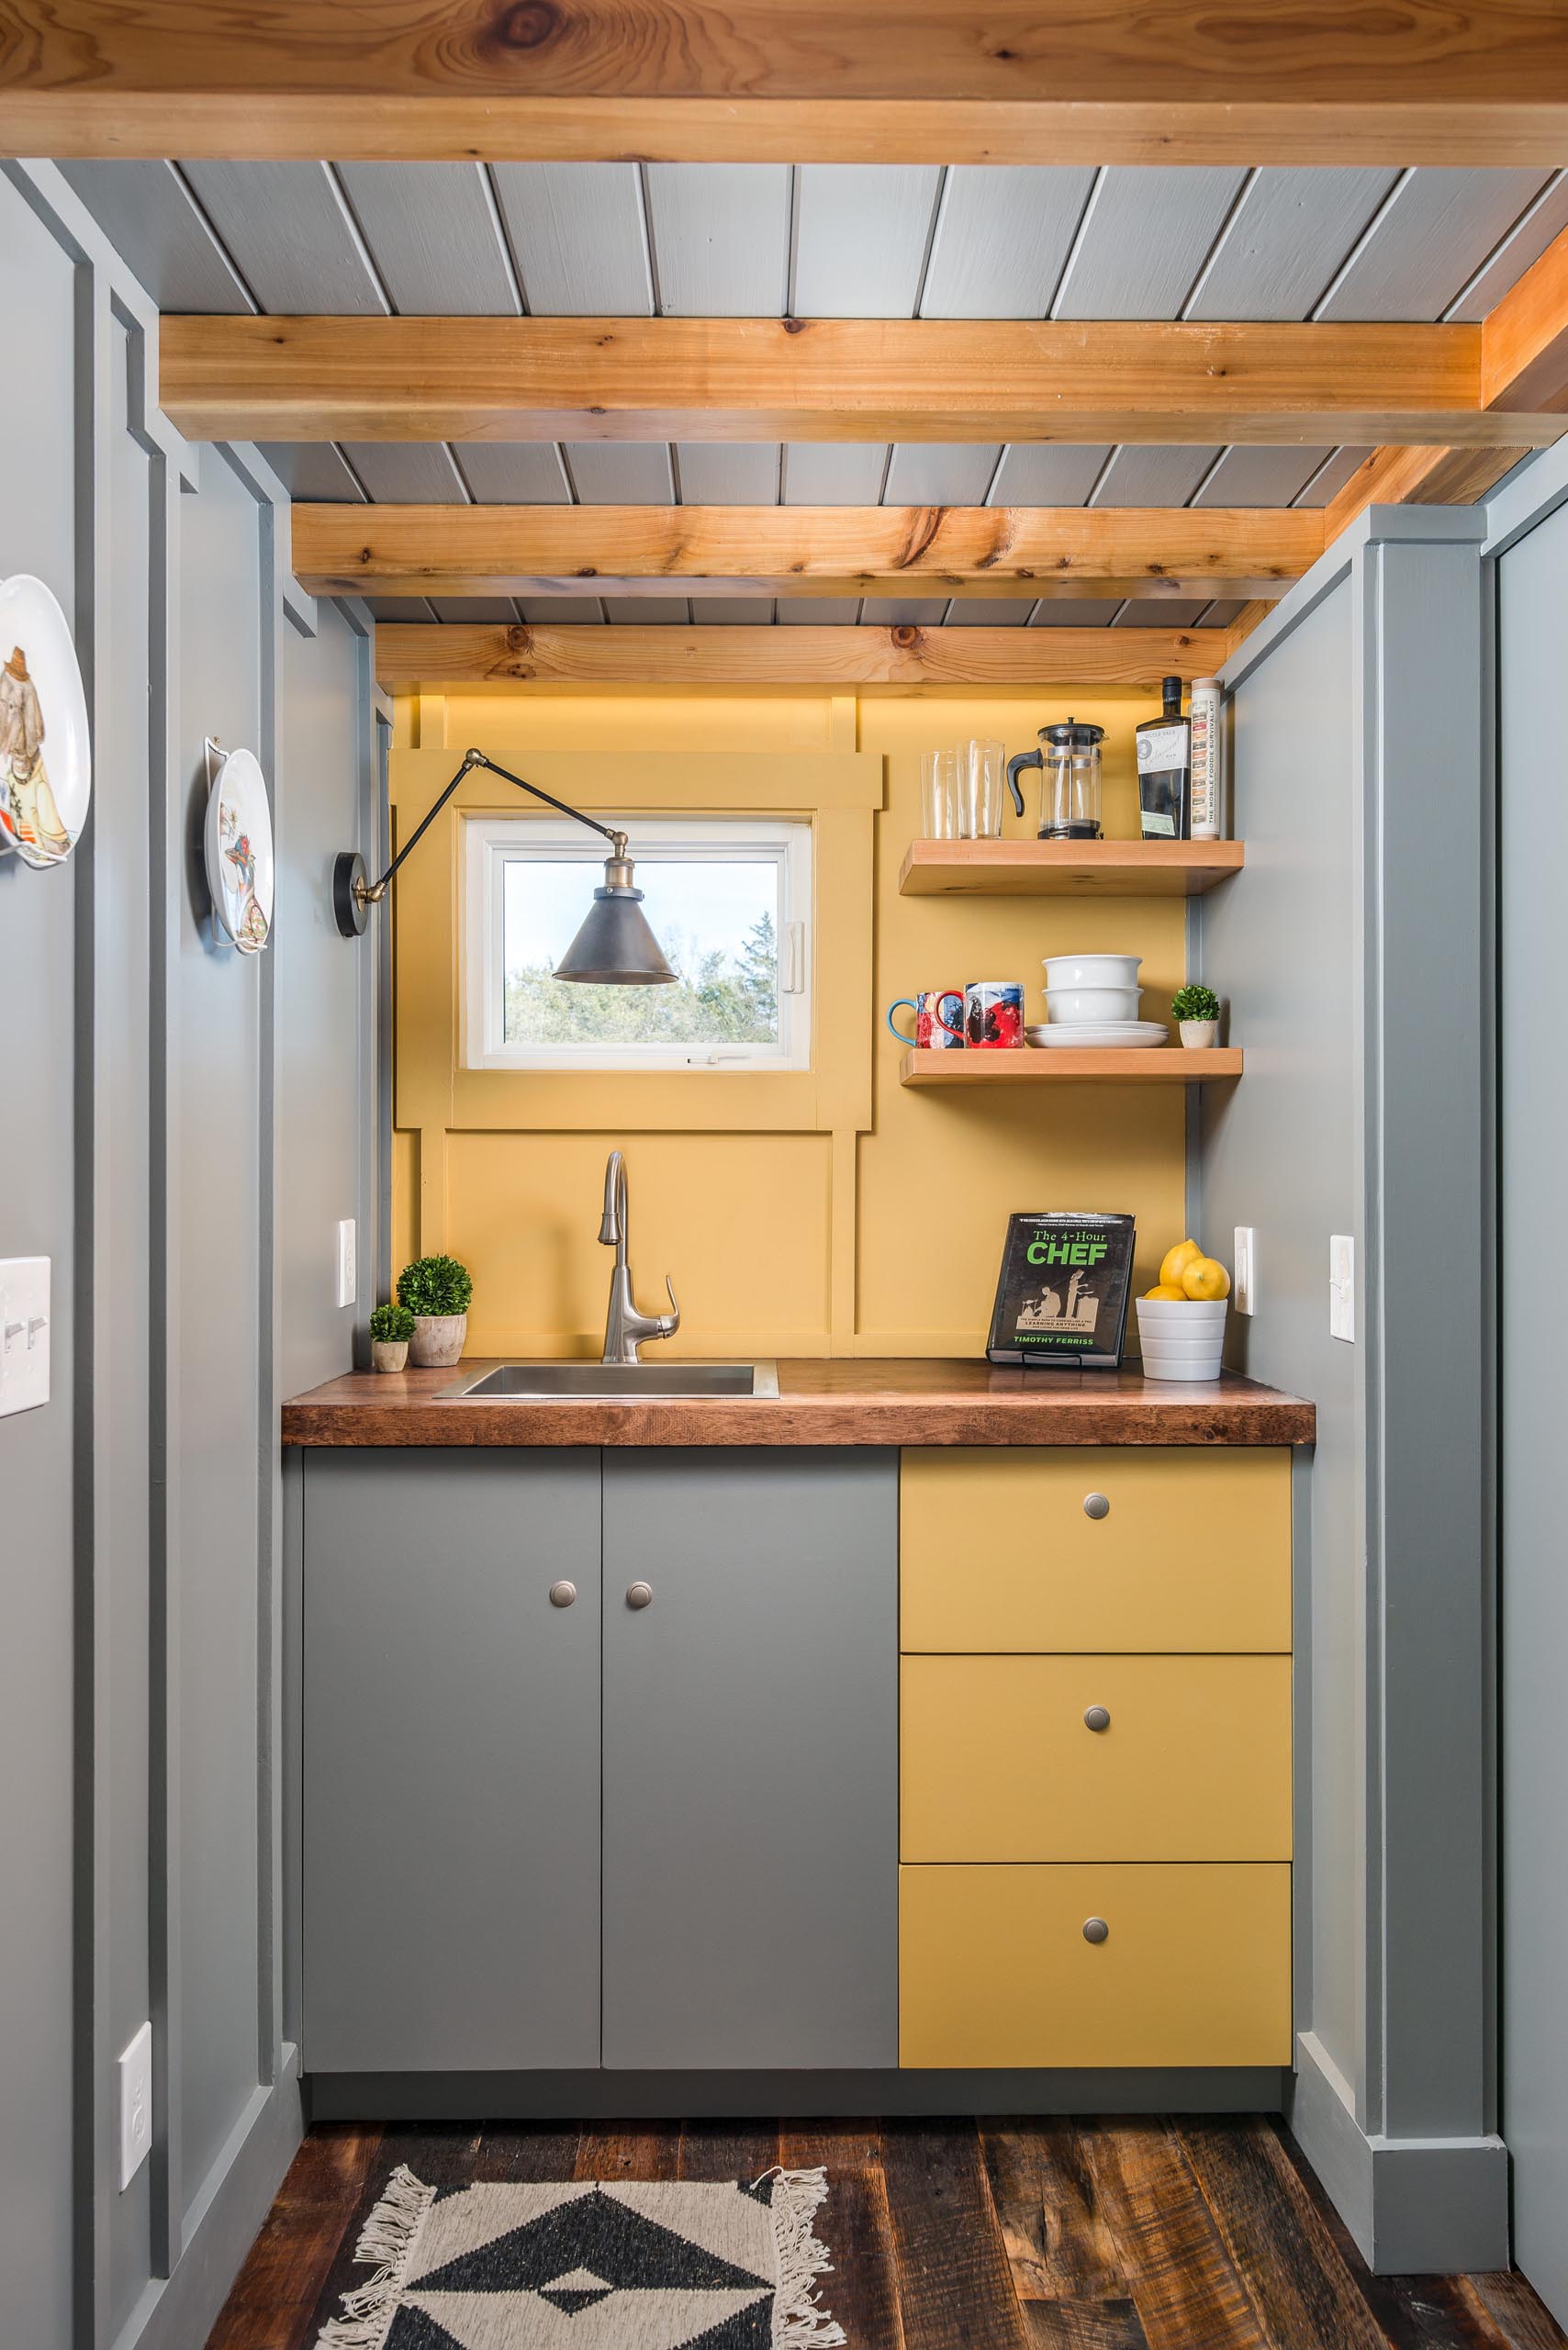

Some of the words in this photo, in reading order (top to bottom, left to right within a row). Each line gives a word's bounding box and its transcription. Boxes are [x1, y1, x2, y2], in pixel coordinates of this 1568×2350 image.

[1033, 1230, 1057, 1240] The
[1061, 1231, 1106, 1241] 4-Hour
[1027, 1241, 1108, 1265] CHEF
[1056, 1337, 1094, 1346] FERRISS
